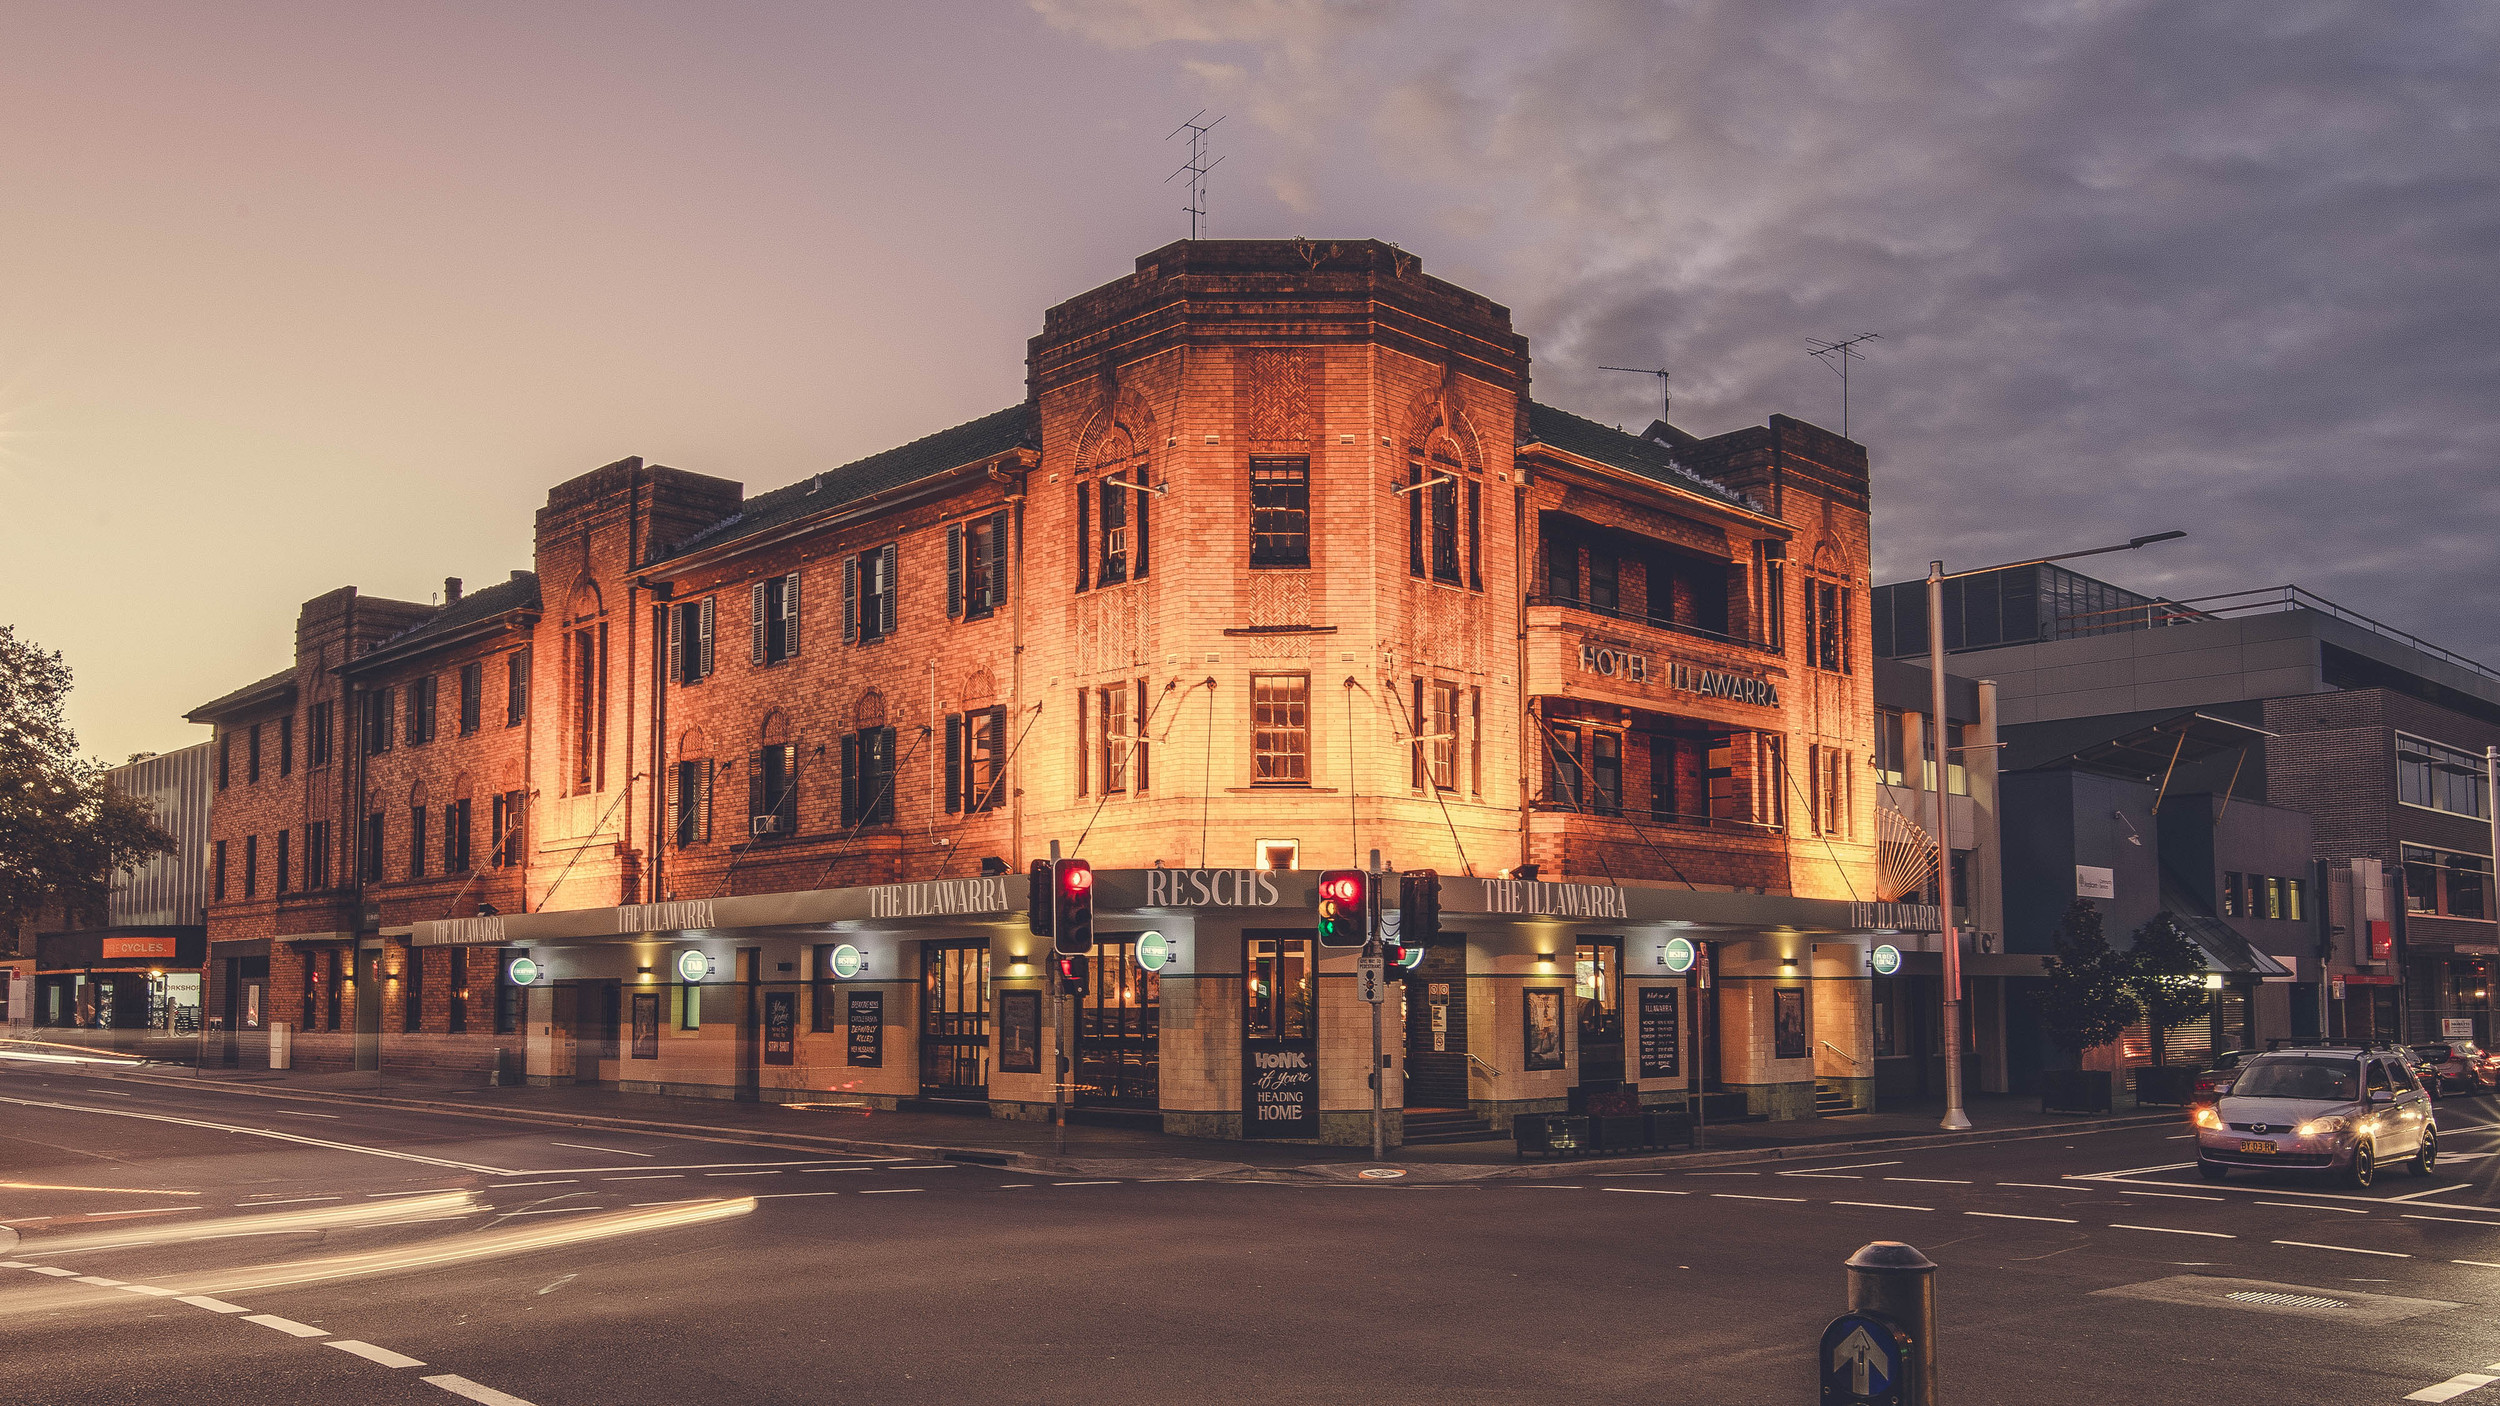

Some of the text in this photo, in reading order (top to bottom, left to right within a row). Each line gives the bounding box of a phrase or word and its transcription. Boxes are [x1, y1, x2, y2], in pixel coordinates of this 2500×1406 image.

[1579, 643, 1781, 709] HOTEL ILLAWARRA
[868, 877, 1009, 917] THE ILLAWARRA
[1146, 869, 1279, 907] RESCHS
[1482, 878, 1628, 918] THE ILLAWARRA
[617, 900, 716, 933] THE ILLAWARRA
[1849, 901, 1875, 928] THE
[433, 917, 506, 944] THE ILLAWARRA
[687, 960, 703, 971] TAB
[1645, 1004, 1672, 1012] ILLAWARRA
[1257, 1092, 1304, 1102] HEADING
[1258, 1105, 1303, 1120] HOME
